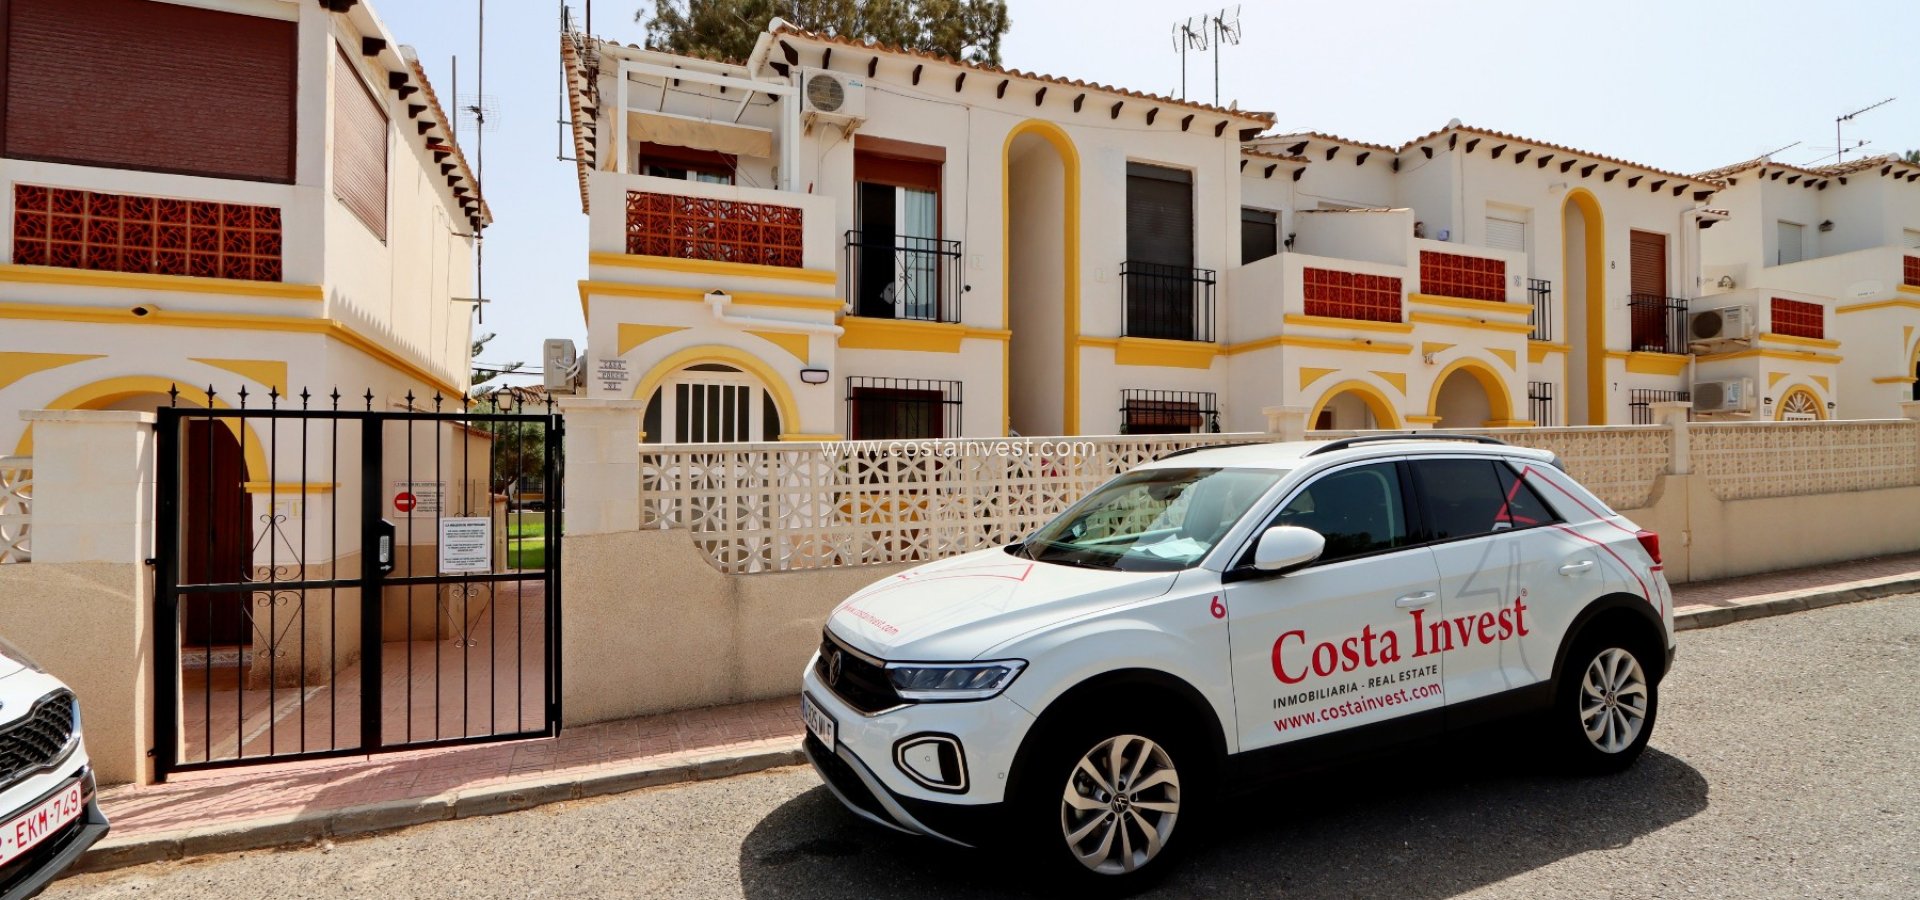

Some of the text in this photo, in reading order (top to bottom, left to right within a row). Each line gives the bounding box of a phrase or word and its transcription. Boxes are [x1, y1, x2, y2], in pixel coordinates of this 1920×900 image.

[1211, 595, 1226, 619] 6
[1271, 624, 1401, 684] Costa
[1273, 682, 1358, 709] INMOBILIARIA
[1368, 673, 1396, 689] REAL
[1399, 664, 1438, 682] ESTATE
[1273, 681, 1442, 732] www.costainvest.com
